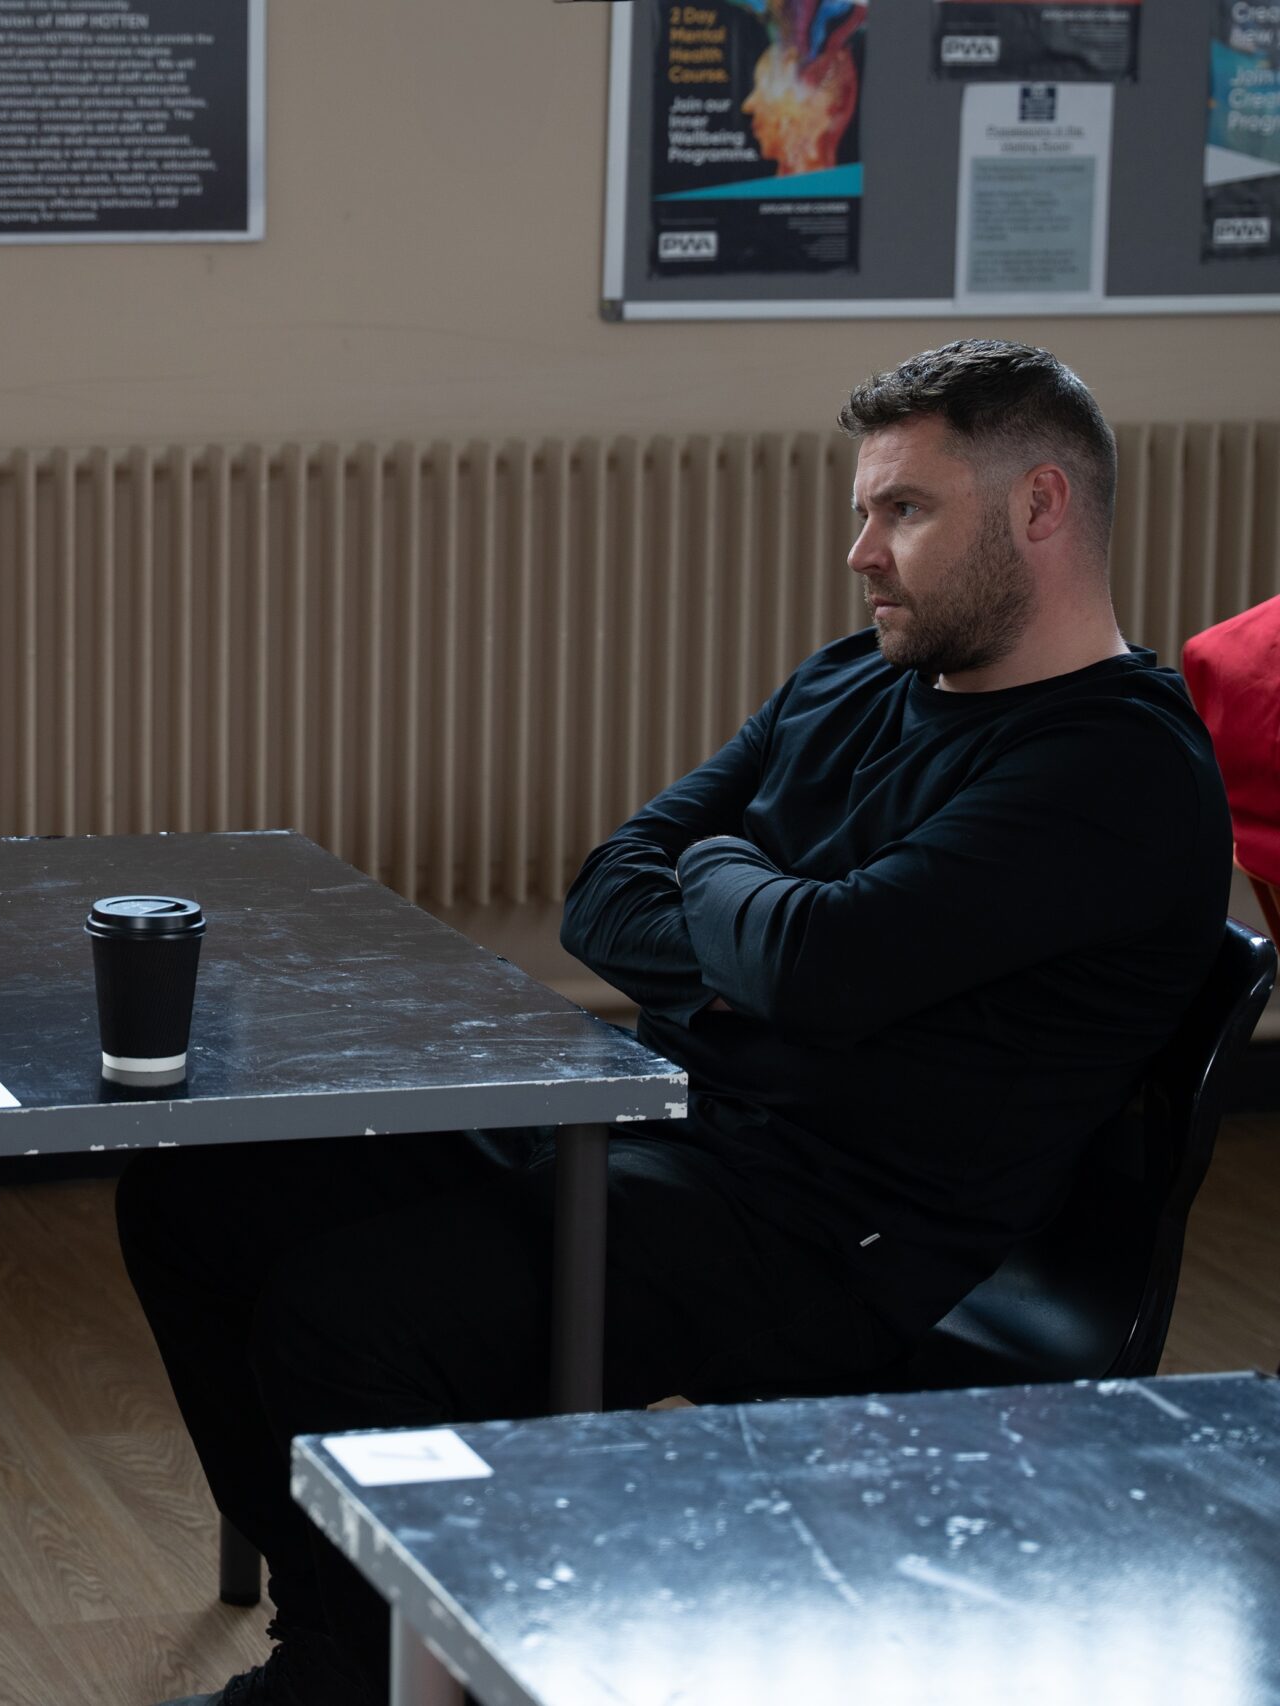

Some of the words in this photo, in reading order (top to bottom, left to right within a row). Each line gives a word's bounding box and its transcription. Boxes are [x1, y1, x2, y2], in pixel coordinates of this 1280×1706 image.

[36, 12, 54, 28] of
[54, 12, 88, 28] HMP
[89, 12, 150, 28] HOTTEN
[683, 6, 717, 26] Day
[6, 32, 40, 44] Prison
[154, 32, 194, 44] provide
[196, 32, 216, 44] the
[669, 26, 727, 44] Mental
[669, 47, 723, 63] Health
[176, 59, 197, 70] will
[670, 96, 702, 113] Join
[704, 98, 731, 113] our
[174, 110, 196, 121] The
[668, 115, 708, 128] Inner
[668, 130, 745, 147] Wellbeing
[667, 147, 759, 166] Programme.
[663, 237, 713, 251] PWA
